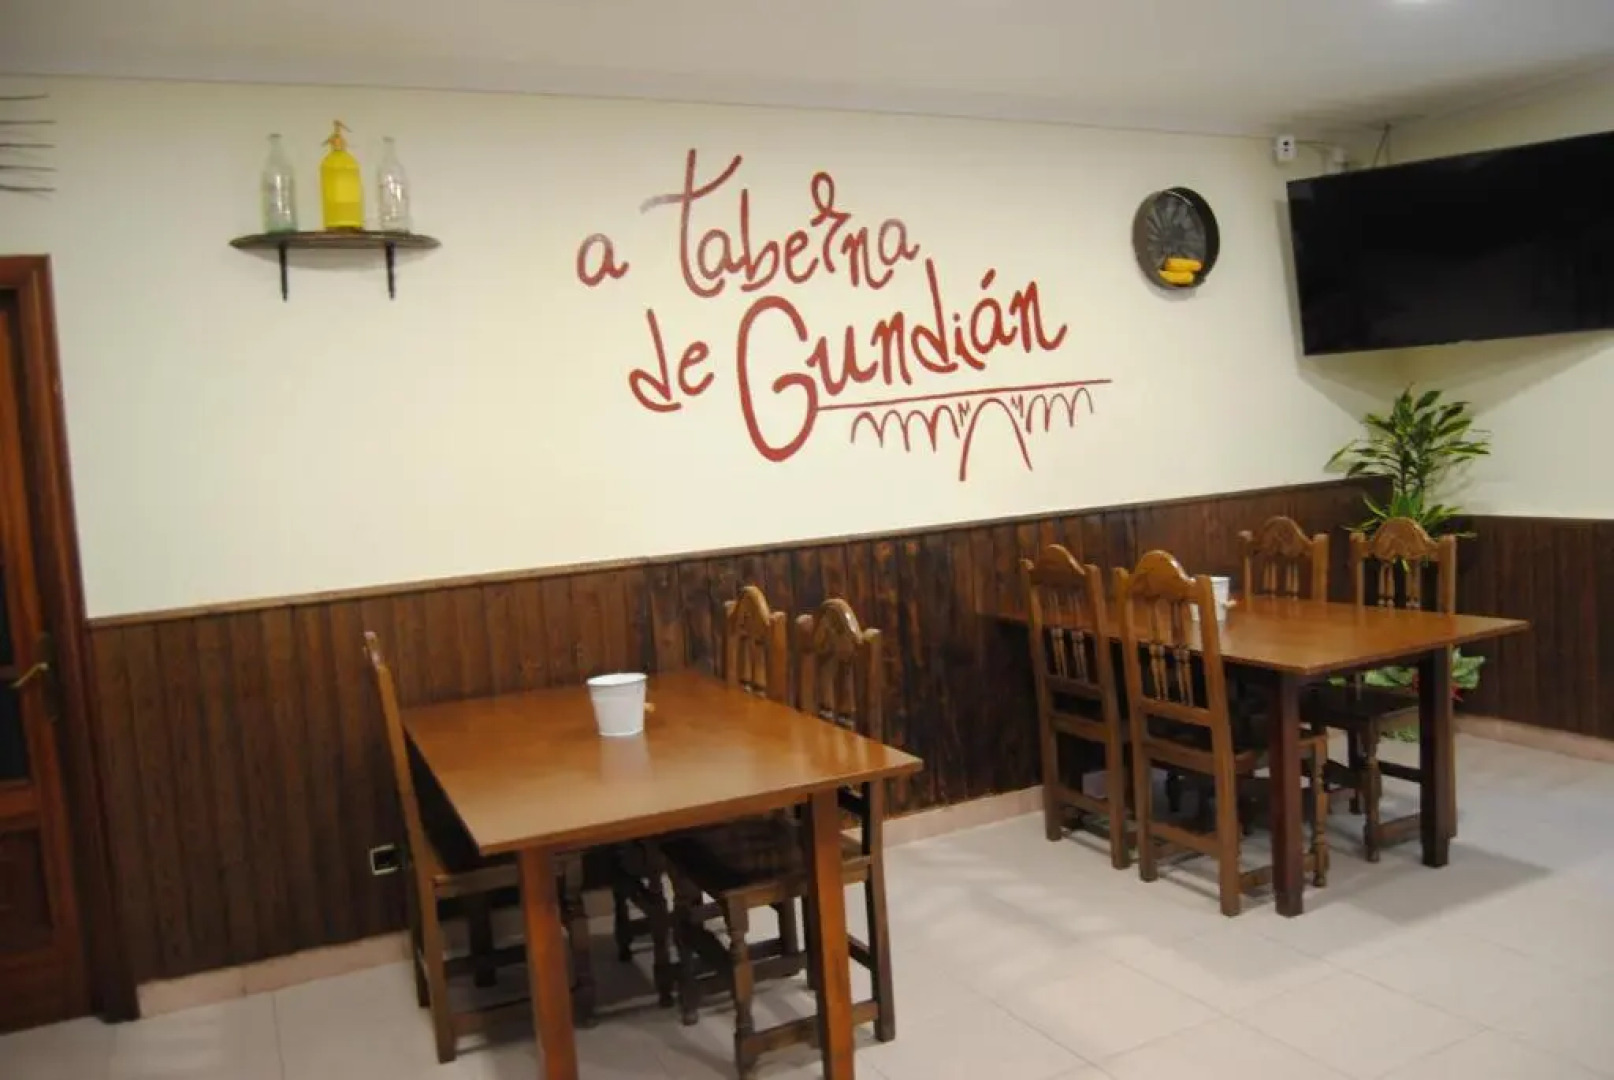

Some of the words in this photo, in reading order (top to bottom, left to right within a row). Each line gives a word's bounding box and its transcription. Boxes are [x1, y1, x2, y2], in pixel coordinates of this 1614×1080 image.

[576, 232, 630, 287] a
[628, 308, 714, 413] de
[736, 257, 1068, 462] Gundián
